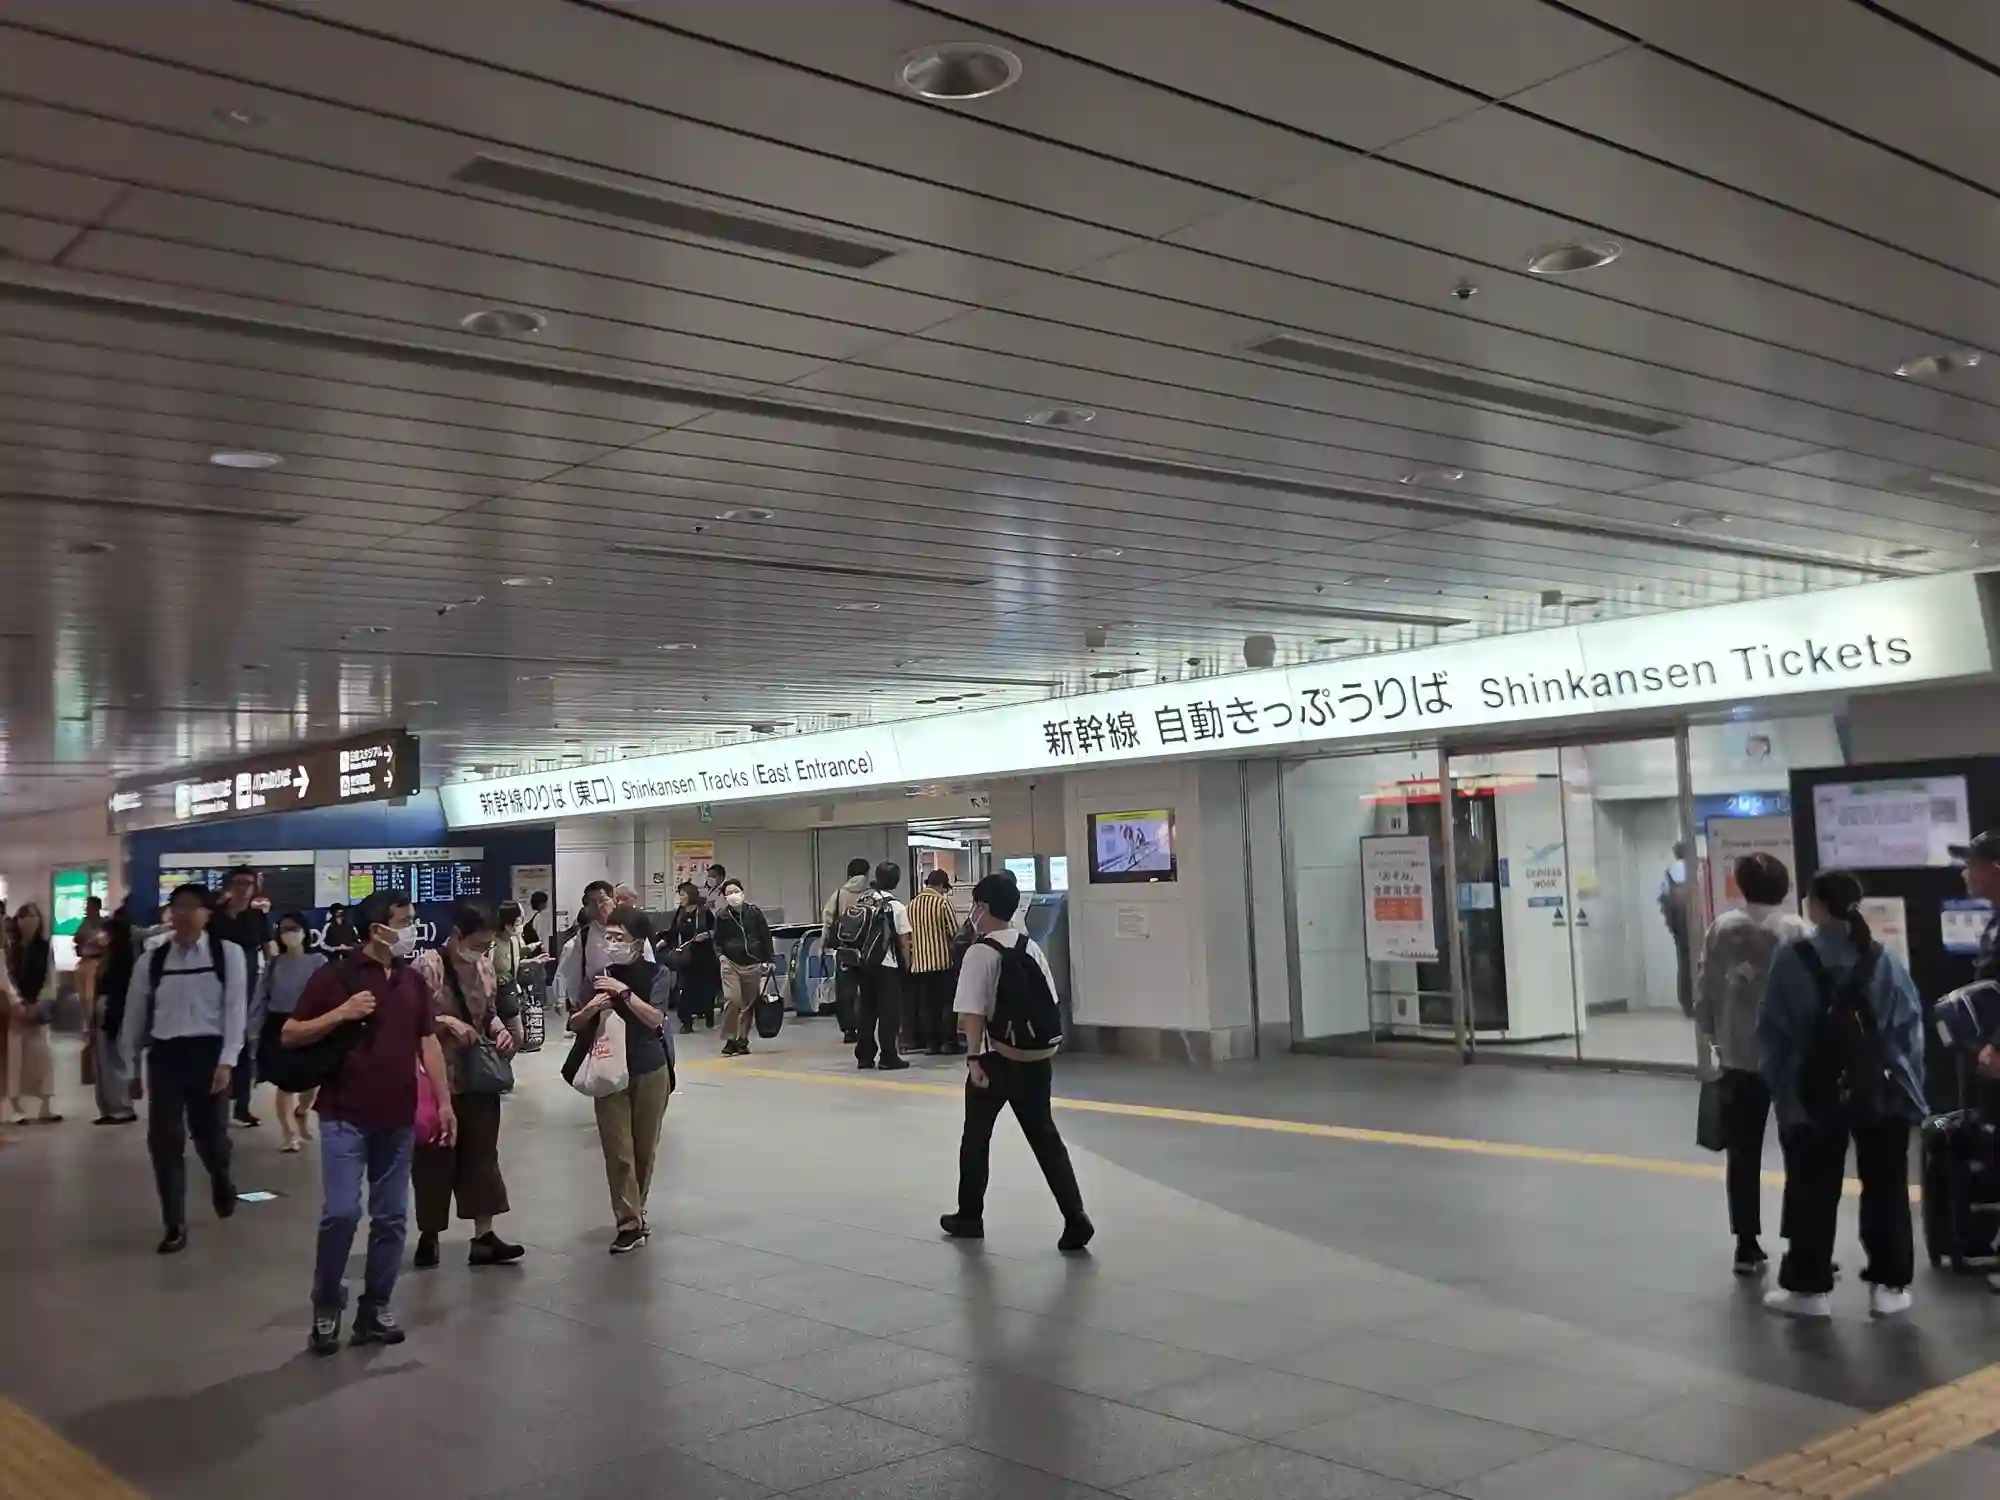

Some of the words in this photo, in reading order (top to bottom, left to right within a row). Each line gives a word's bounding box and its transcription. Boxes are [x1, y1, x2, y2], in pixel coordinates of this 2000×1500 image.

[1043, 710, 1141, 758] 新幹線
[1154, 671, 1453, 745] 自動きっぷうりば
[1480, 657, 1717, 709] Shinkansen
[1730, 633, 1912, 682] Tickets
[621, 776, 697, 800] Shinkansen
[698, 768, 749, 791] Tracks
[752, 761, 792, 785] (East
[795, 750, 874, 781] Entrance)
